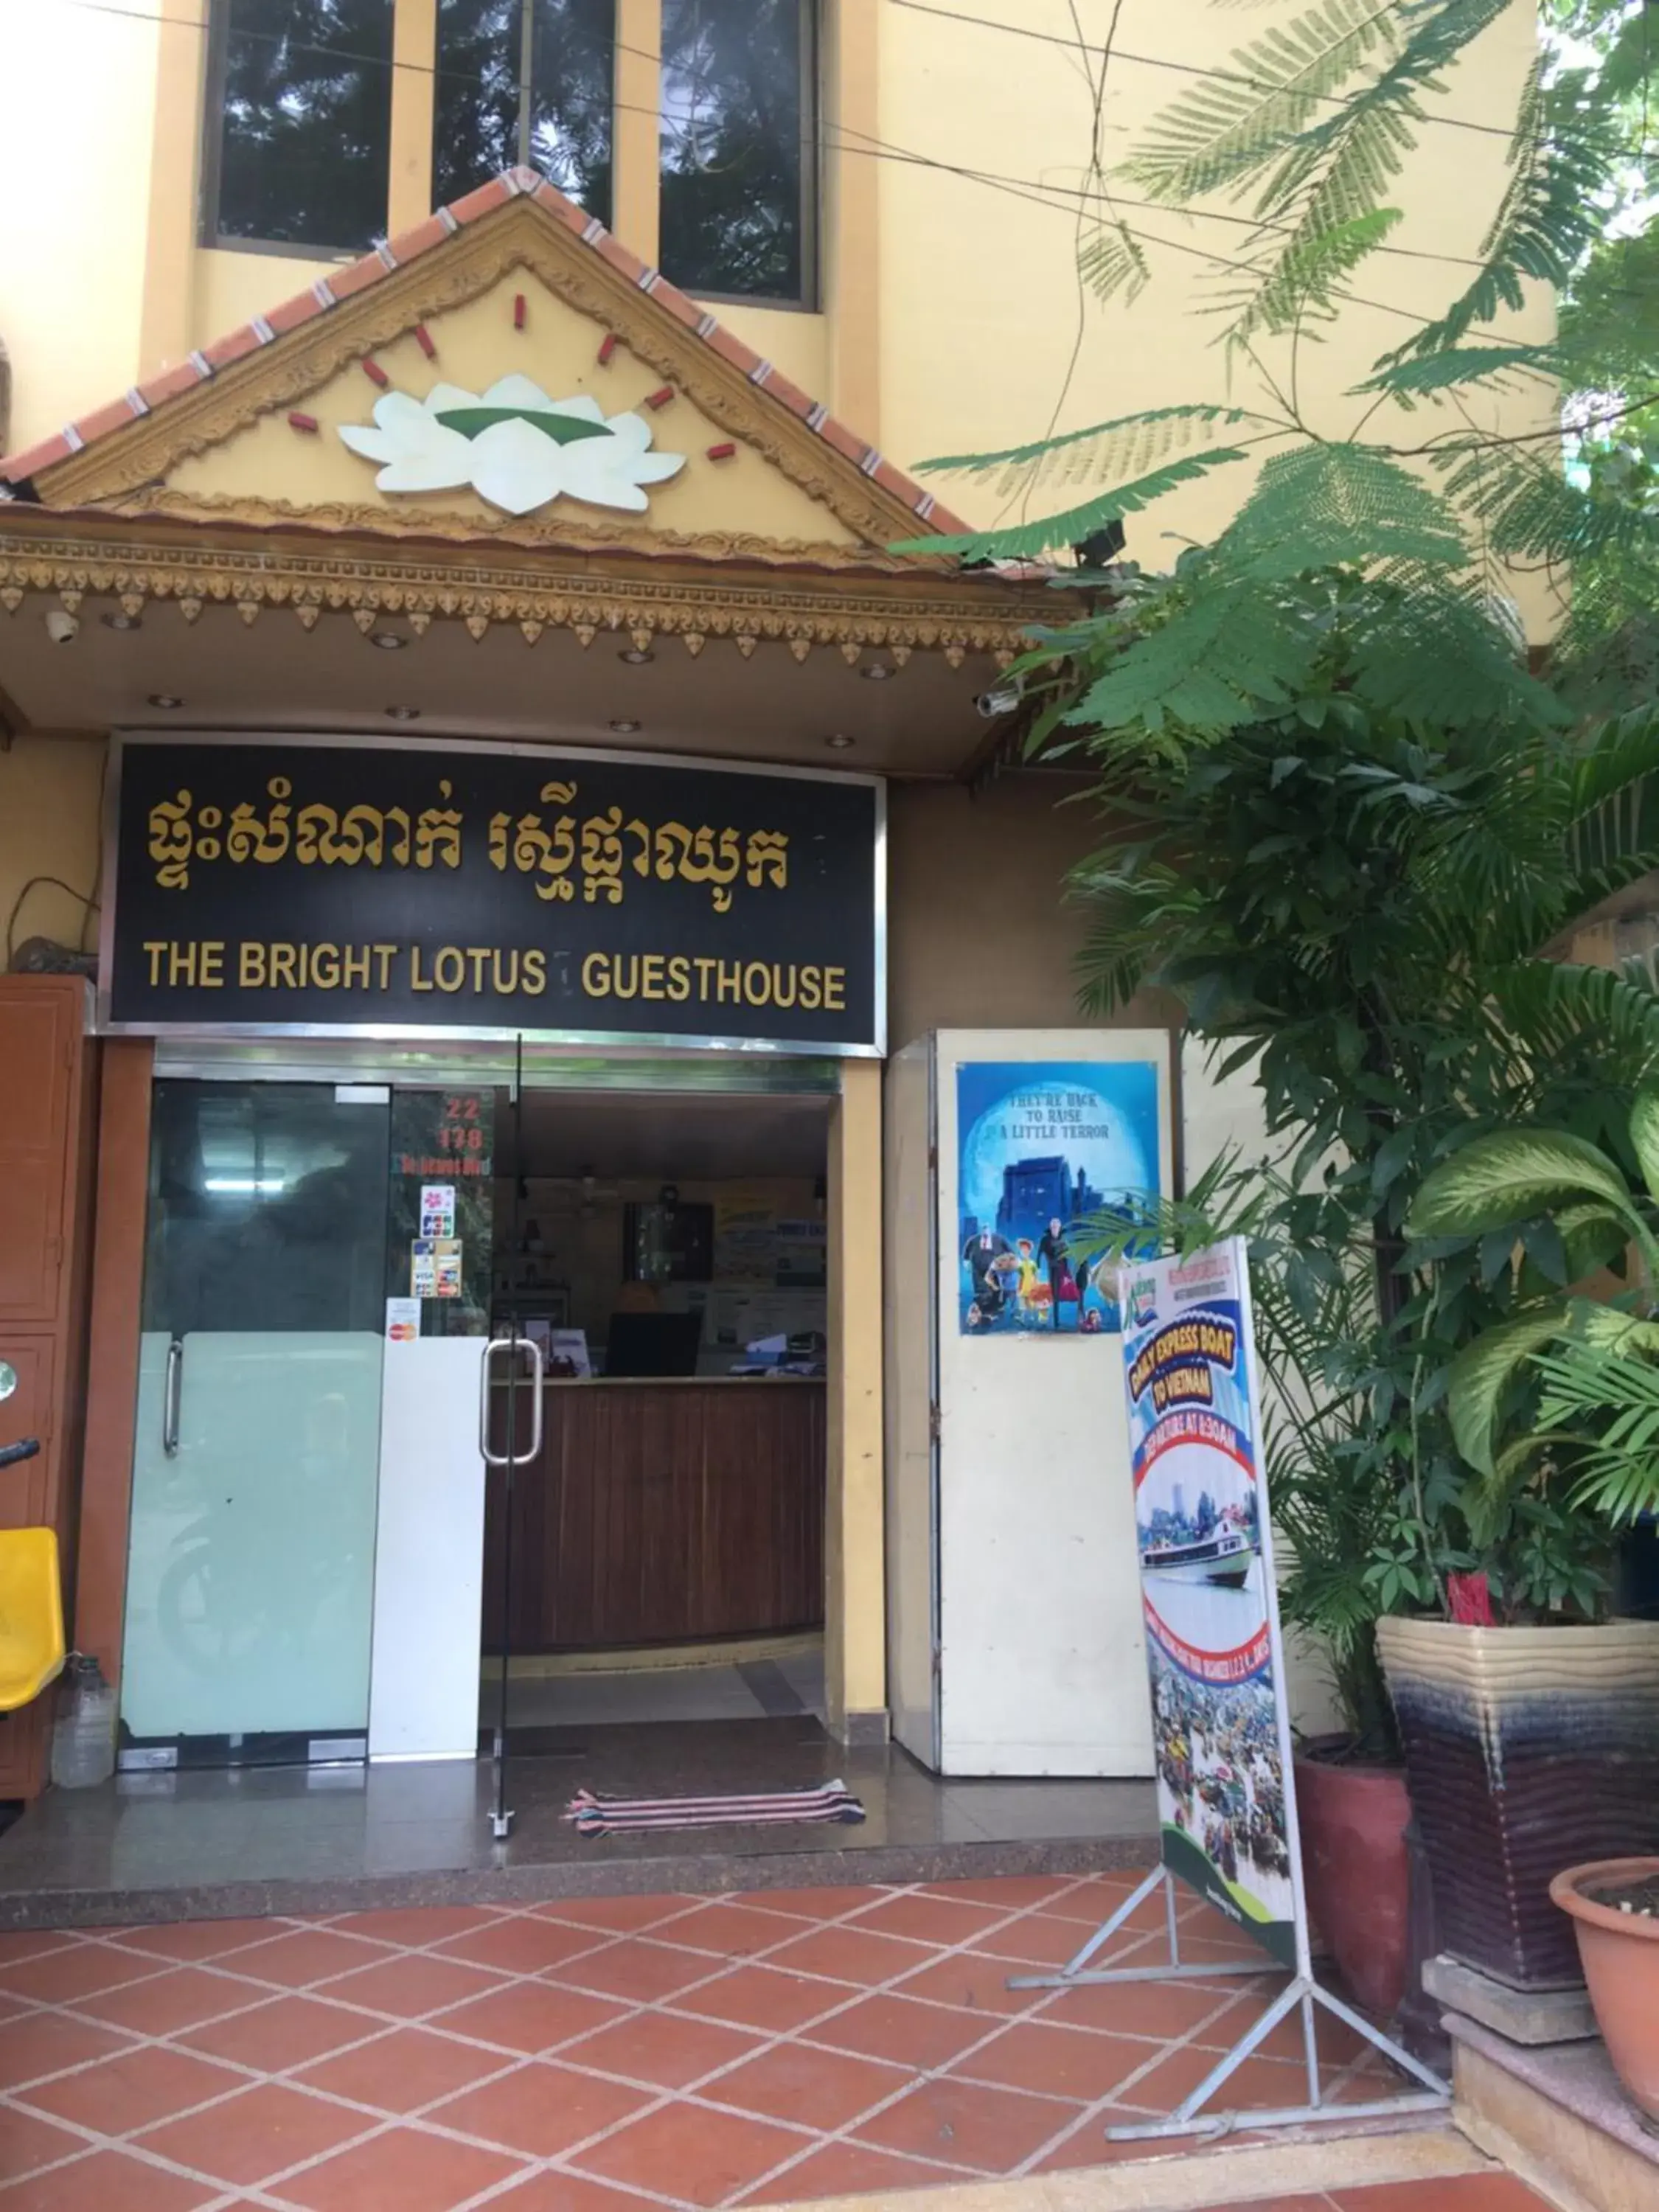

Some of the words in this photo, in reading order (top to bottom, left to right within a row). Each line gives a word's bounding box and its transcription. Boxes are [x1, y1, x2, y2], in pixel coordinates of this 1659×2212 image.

[148, 776, 463, 891] ផ្ទះសំណាក់
[143, 941, 225, 988] THE
[239, 942, 399, 990] BRIGHT
[411, 946, 546, 995] LOTUS
[582, 952, 846, 1010] GUESTHOUSE
[446, 1097, 481, 1120] 22
[1011, 1092, 1062, 1107] THEY'RE
[1067, 1092, 1098, 1107] BACK
[1026, 1109, 1043, 1122] TO
[1047, 1109, 1082, 1123] RAISE
[1000, 1124, 1008, 1139] A
[1012, 1124, 1057, 1139] LITTLE
[1061, 1124, 1110, 1139] TERROR
[1130, 1345, 1156, 1395] DAILY
[1155, 1324, 1199, 1364] EXPRESS
[1200, 1324, 1234, 1363] BOAT
[1154, 1379, 1167, 1407] TO
[1166, 1368, 1211, 1399] VIETNAM
[1186, 1411, 1197, 1435] AT
